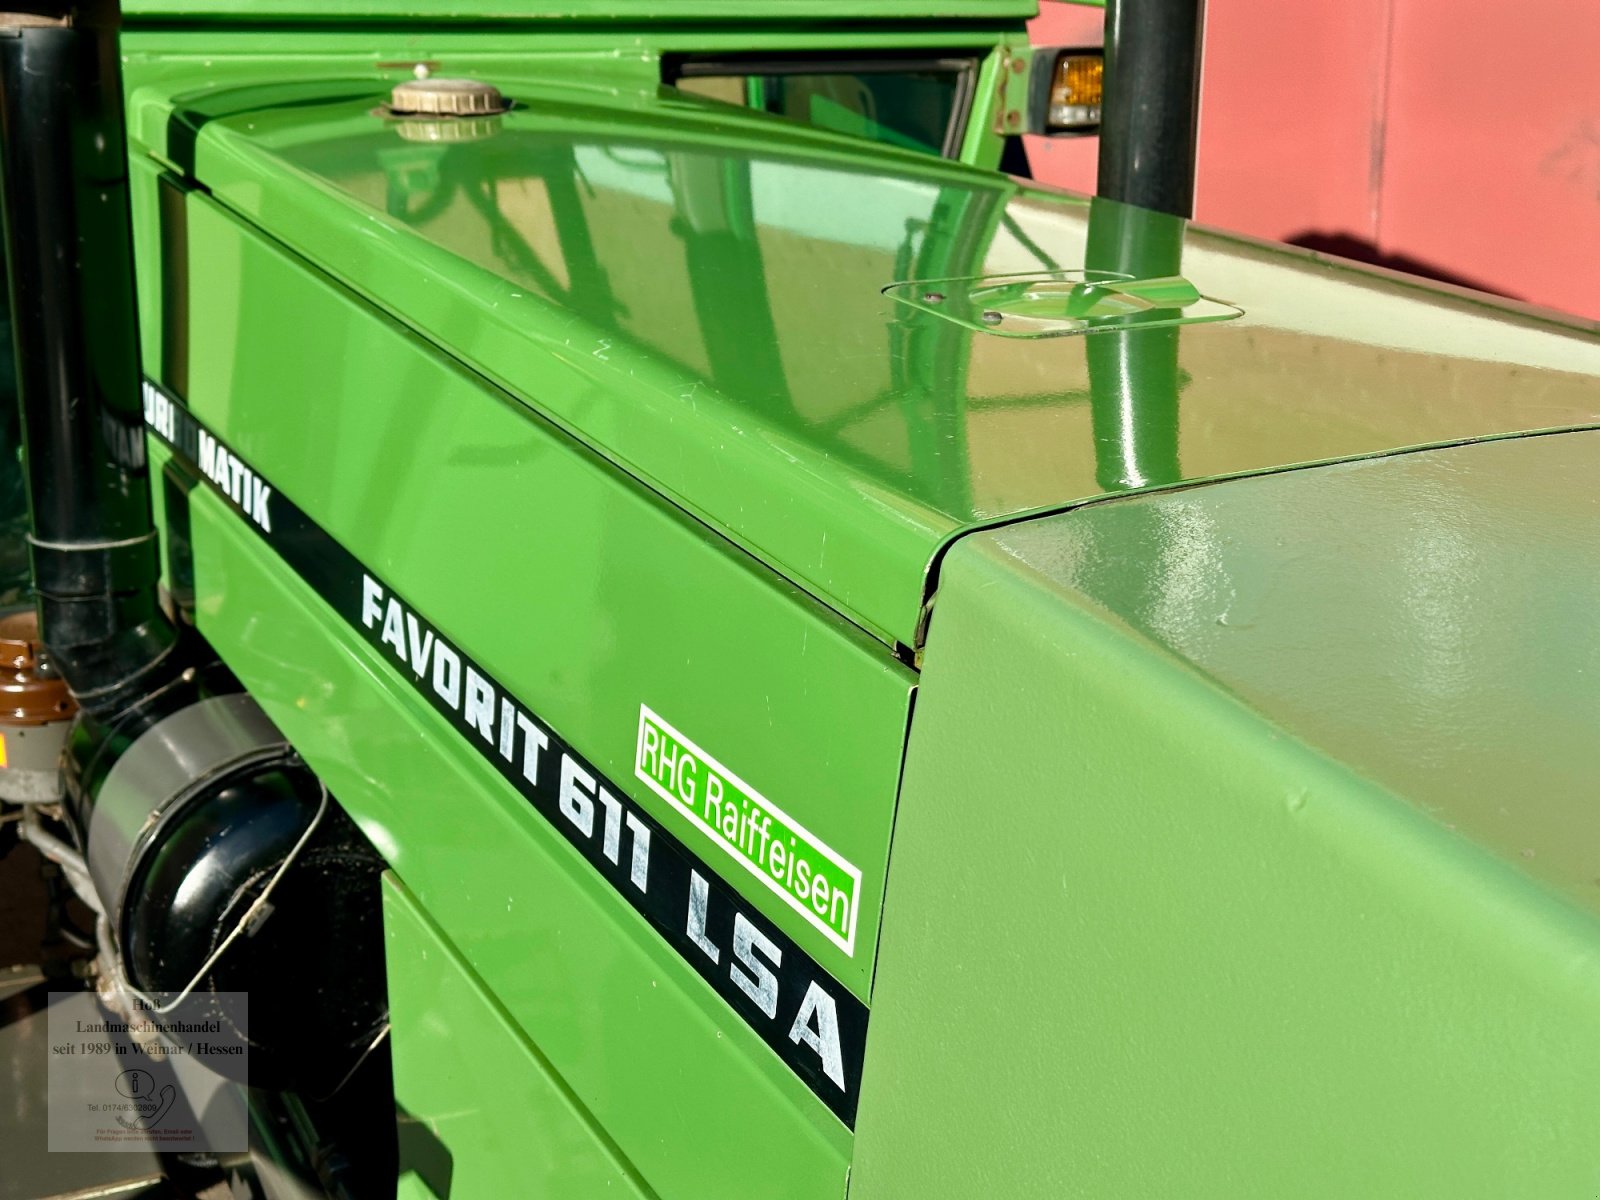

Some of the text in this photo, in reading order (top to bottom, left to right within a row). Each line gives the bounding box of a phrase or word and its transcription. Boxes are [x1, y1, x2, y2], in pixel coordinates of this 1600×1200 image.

[362, 574, 846, 1093] FAVORIT 611 LSA
[641, 721, 850, 934] RHG Raiffeisen
